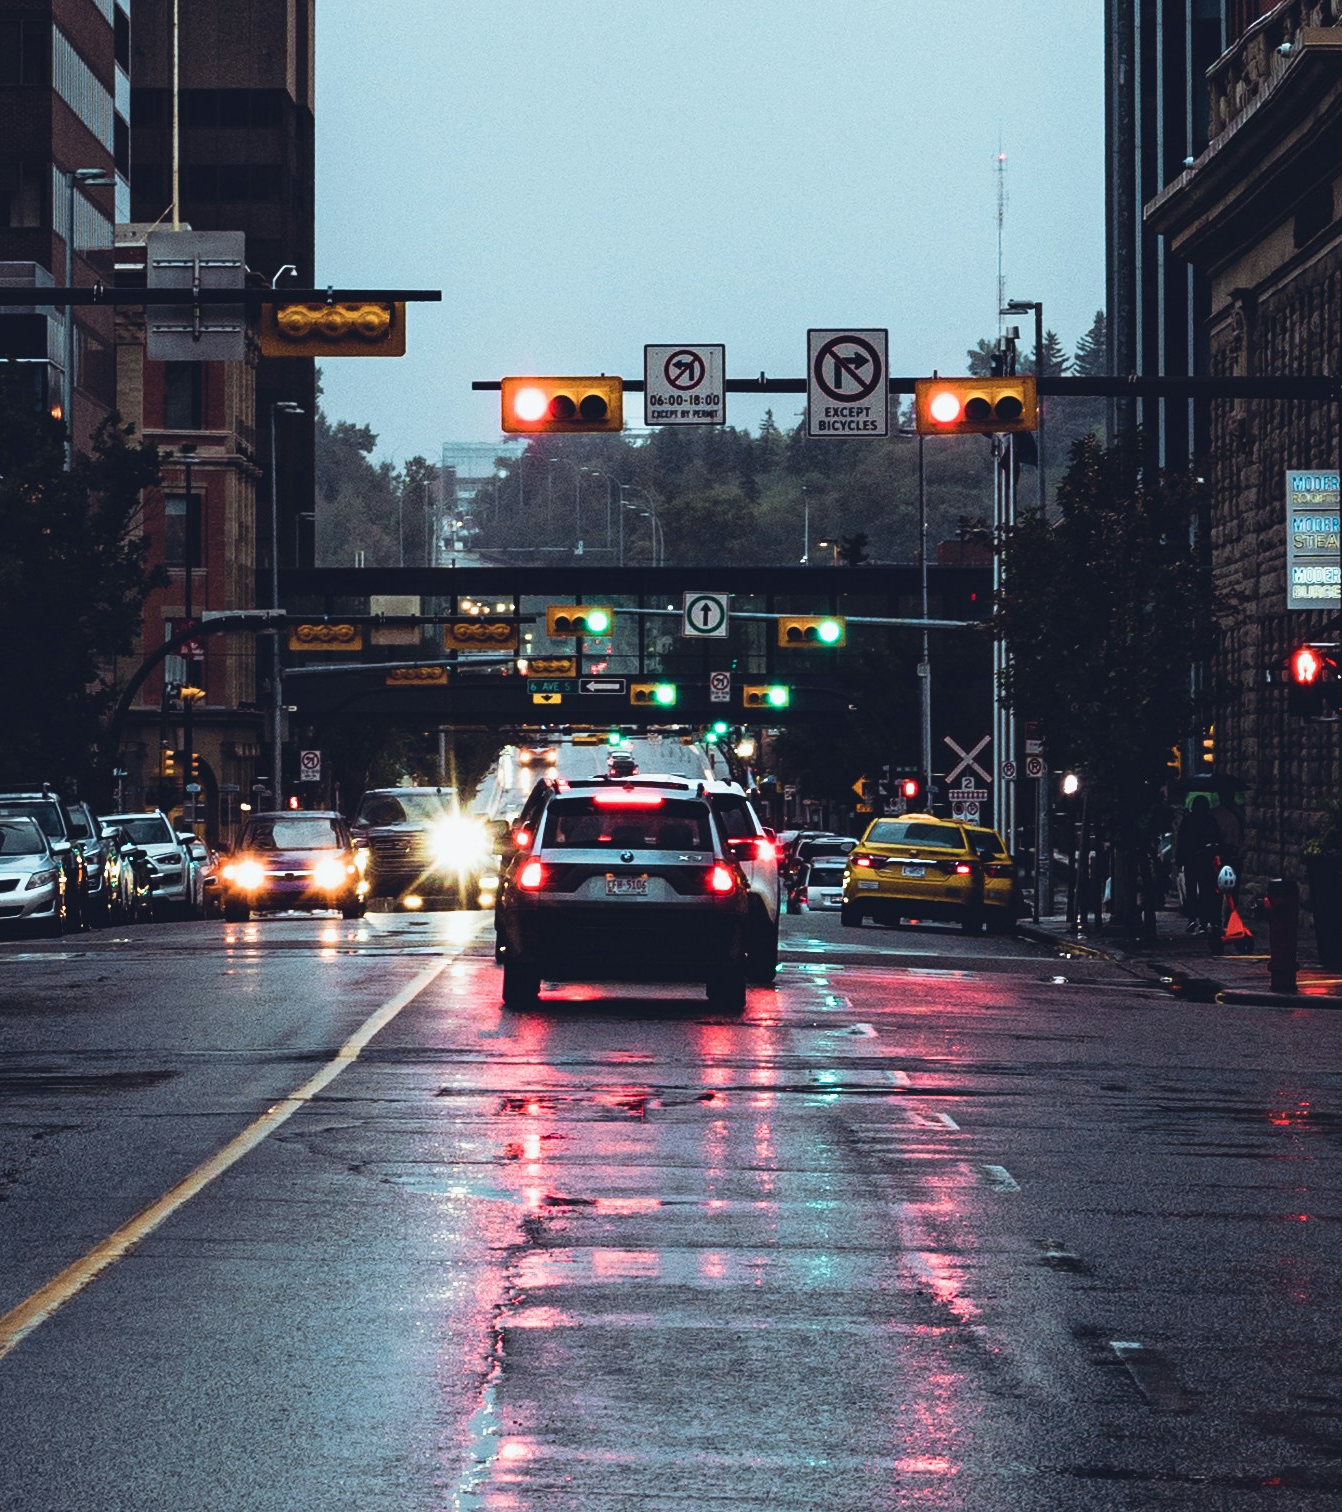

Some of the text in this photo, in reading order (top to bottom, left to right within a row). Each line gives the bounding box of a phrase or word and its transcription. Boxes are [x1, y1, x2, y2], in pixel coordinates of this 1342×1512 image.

[650, 394, 720, 406] 06:00-18:00
[651, 409, 718, 419] EXCEPT BY PERMIT
[824, 406, 871, 418] EXCEPT
[818, 420, 877, 431] BICYCLES
[1292, 476, 1340, 492] MODER
[1292, 517, 1340, 533] MODER
[1293, 534, 1340, 549] STEA
[1292, 566, 1341, 584] MODER
[1292, 584, 1341, 599] BURGE
[530, 682, 571, 691] 6 AVE S
[964, 777, 972, 789] 2
